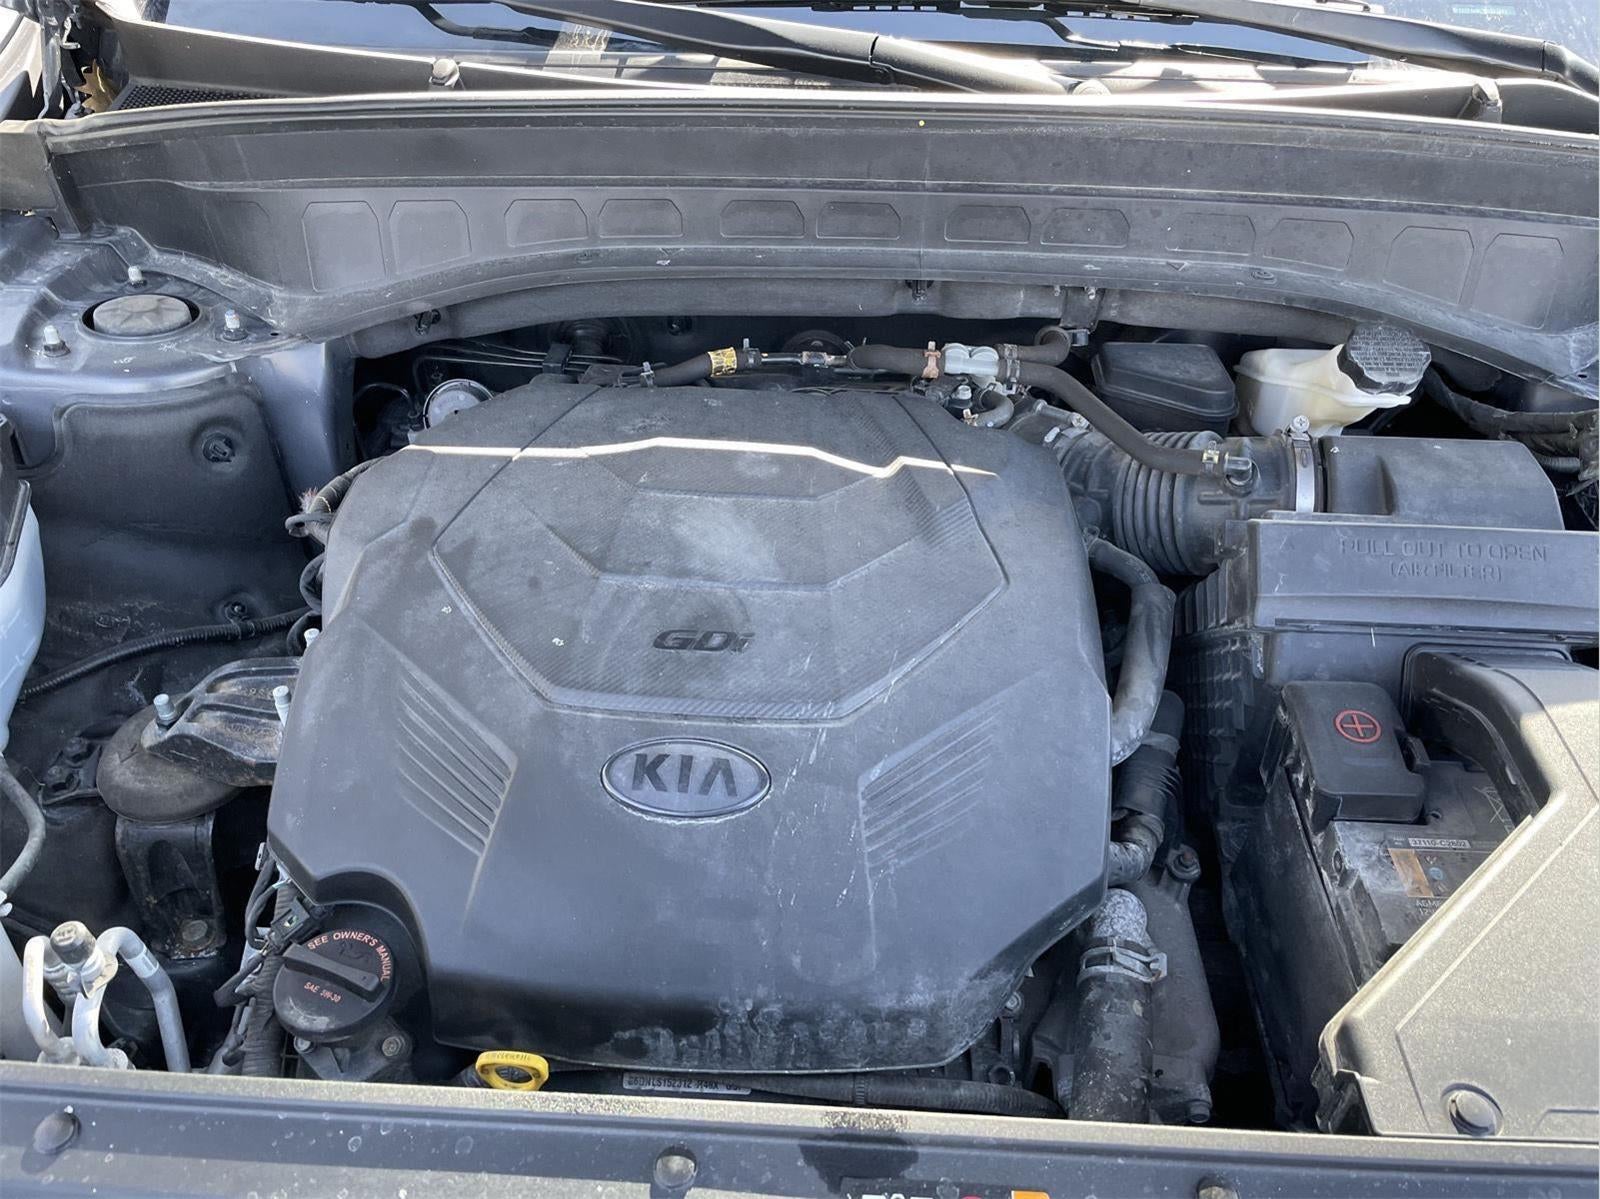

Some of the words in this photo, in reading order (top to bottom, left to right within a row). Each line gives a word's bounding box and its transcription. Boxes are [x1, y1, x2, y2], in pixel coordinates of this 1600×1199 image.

[1340, 538, 1396, 556] PULL
[1402, 540, 1444, 559] OUT
[1457, 541, 1483, 560] TO
[1488, 542, 1549, 562] OPEN
[653, 630, 755, 653] GDi
[632, 753, 738, 798] KIA
[307, 935, 329, 950] SEE
[333, 931, 378, 947] OWNER'S
[375, 945, 393, 983] MANUAL
[303, 981, 320, 994] SAE
